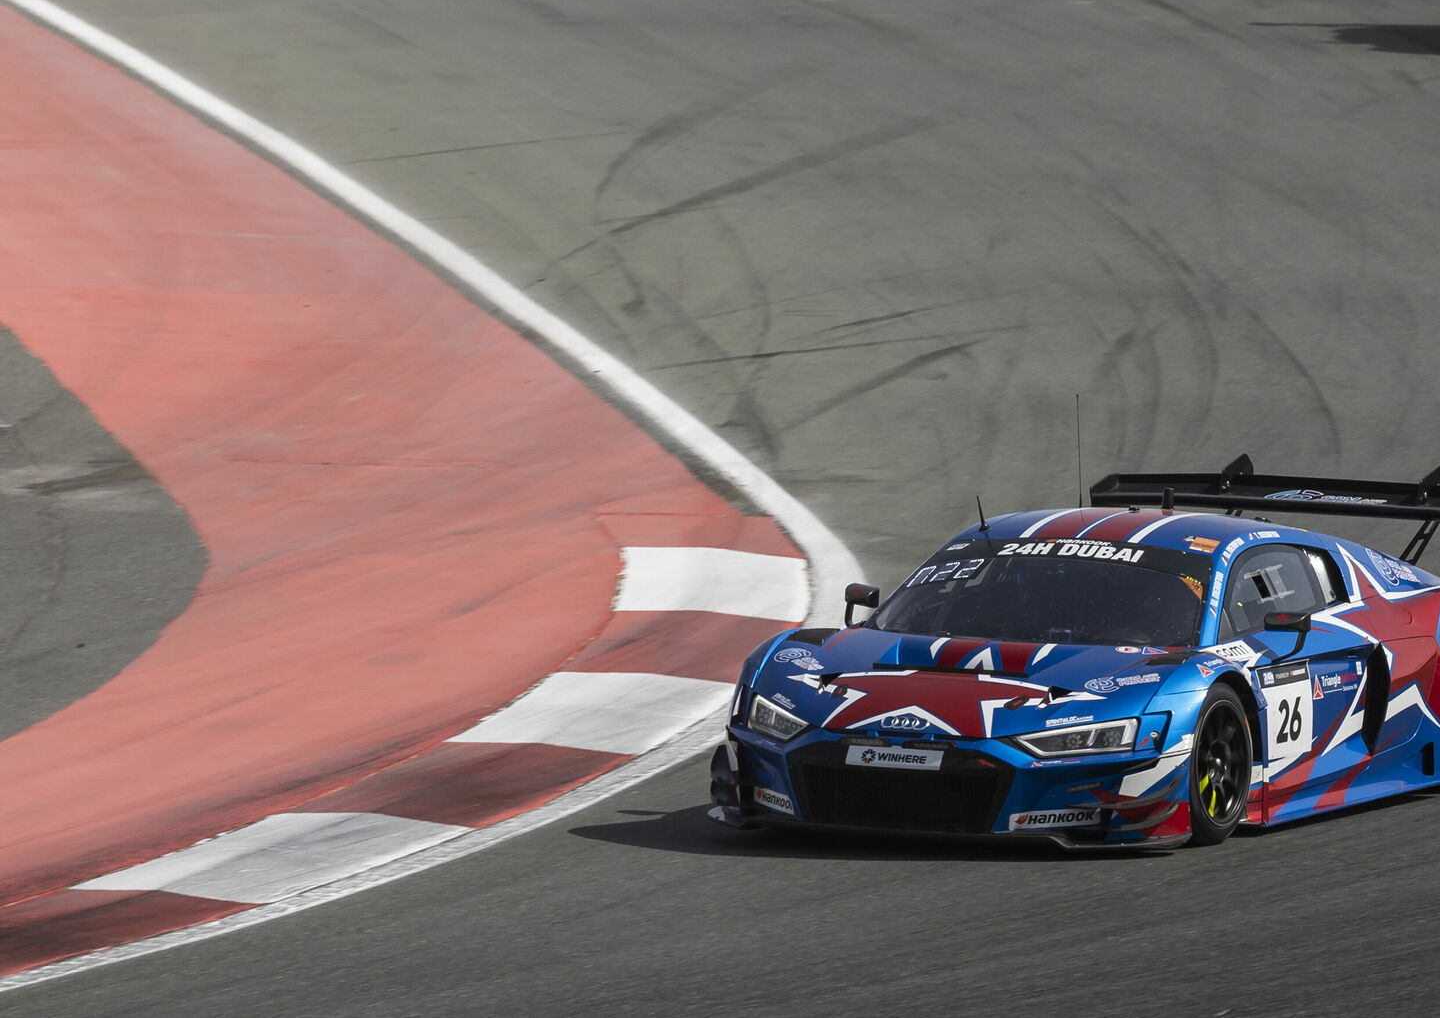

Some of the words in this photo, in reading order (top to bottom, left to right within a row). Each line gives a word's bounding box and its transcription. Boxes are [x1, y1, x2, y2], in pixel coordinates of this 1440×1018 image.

[997, 542, 1055, 557] 24H
[1057, 543, 1145, 564] DUBAI
[1320, 673, 1342, 688] Triangle
[1276, 696, 1302, 744] 26
[877, 752, 927, 765] WINHERE
[761, 792, 793, 811] HANKOO
